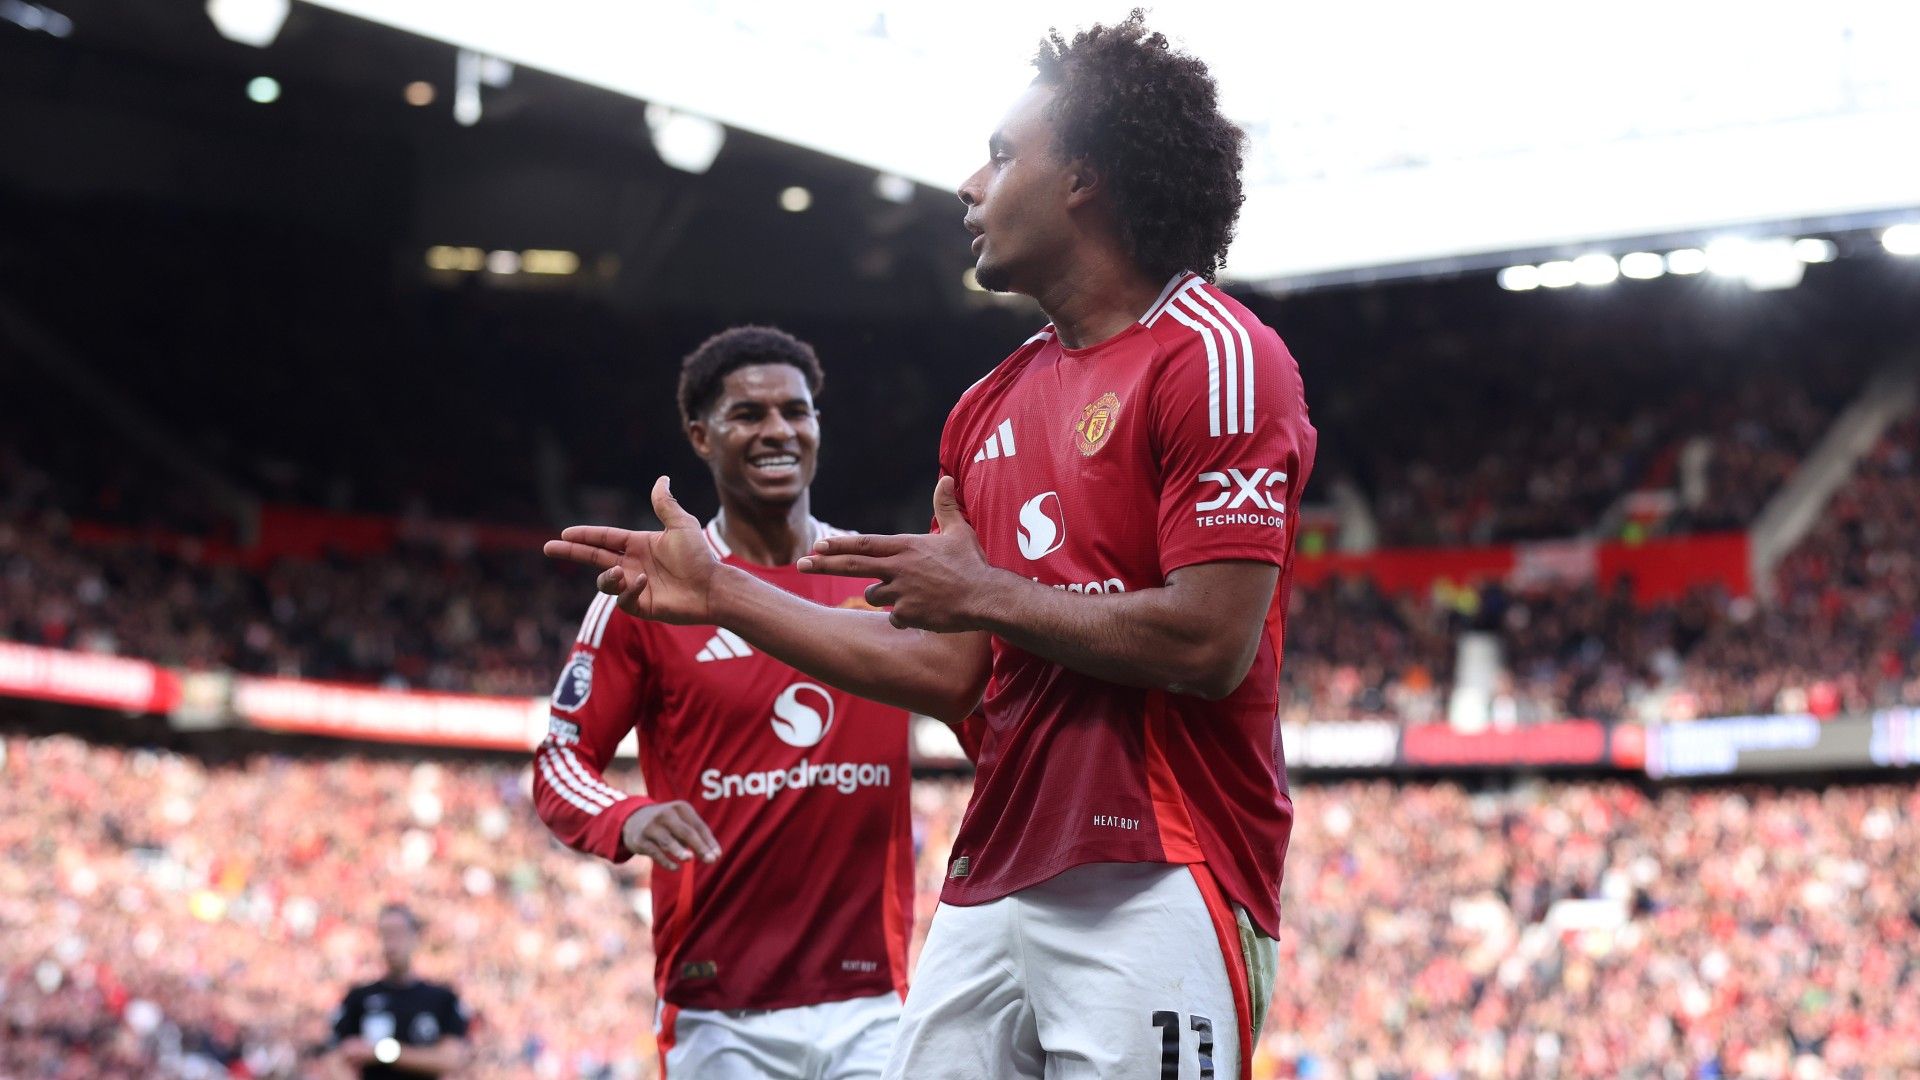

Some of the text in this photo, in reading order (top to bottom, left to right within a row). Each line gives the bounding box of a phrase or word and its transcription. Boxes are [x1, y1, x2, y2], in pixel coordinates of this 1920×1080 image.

[1196, 468, 1287, 514] DXC
[1196, 513, 1284, 529] TECHNOLOGY
[701, 758, 890, 800] Snapdragon
[1093, 815, 1139, 830] HEAT.RDY
[1152, 1010, 1214, 1080] 11
